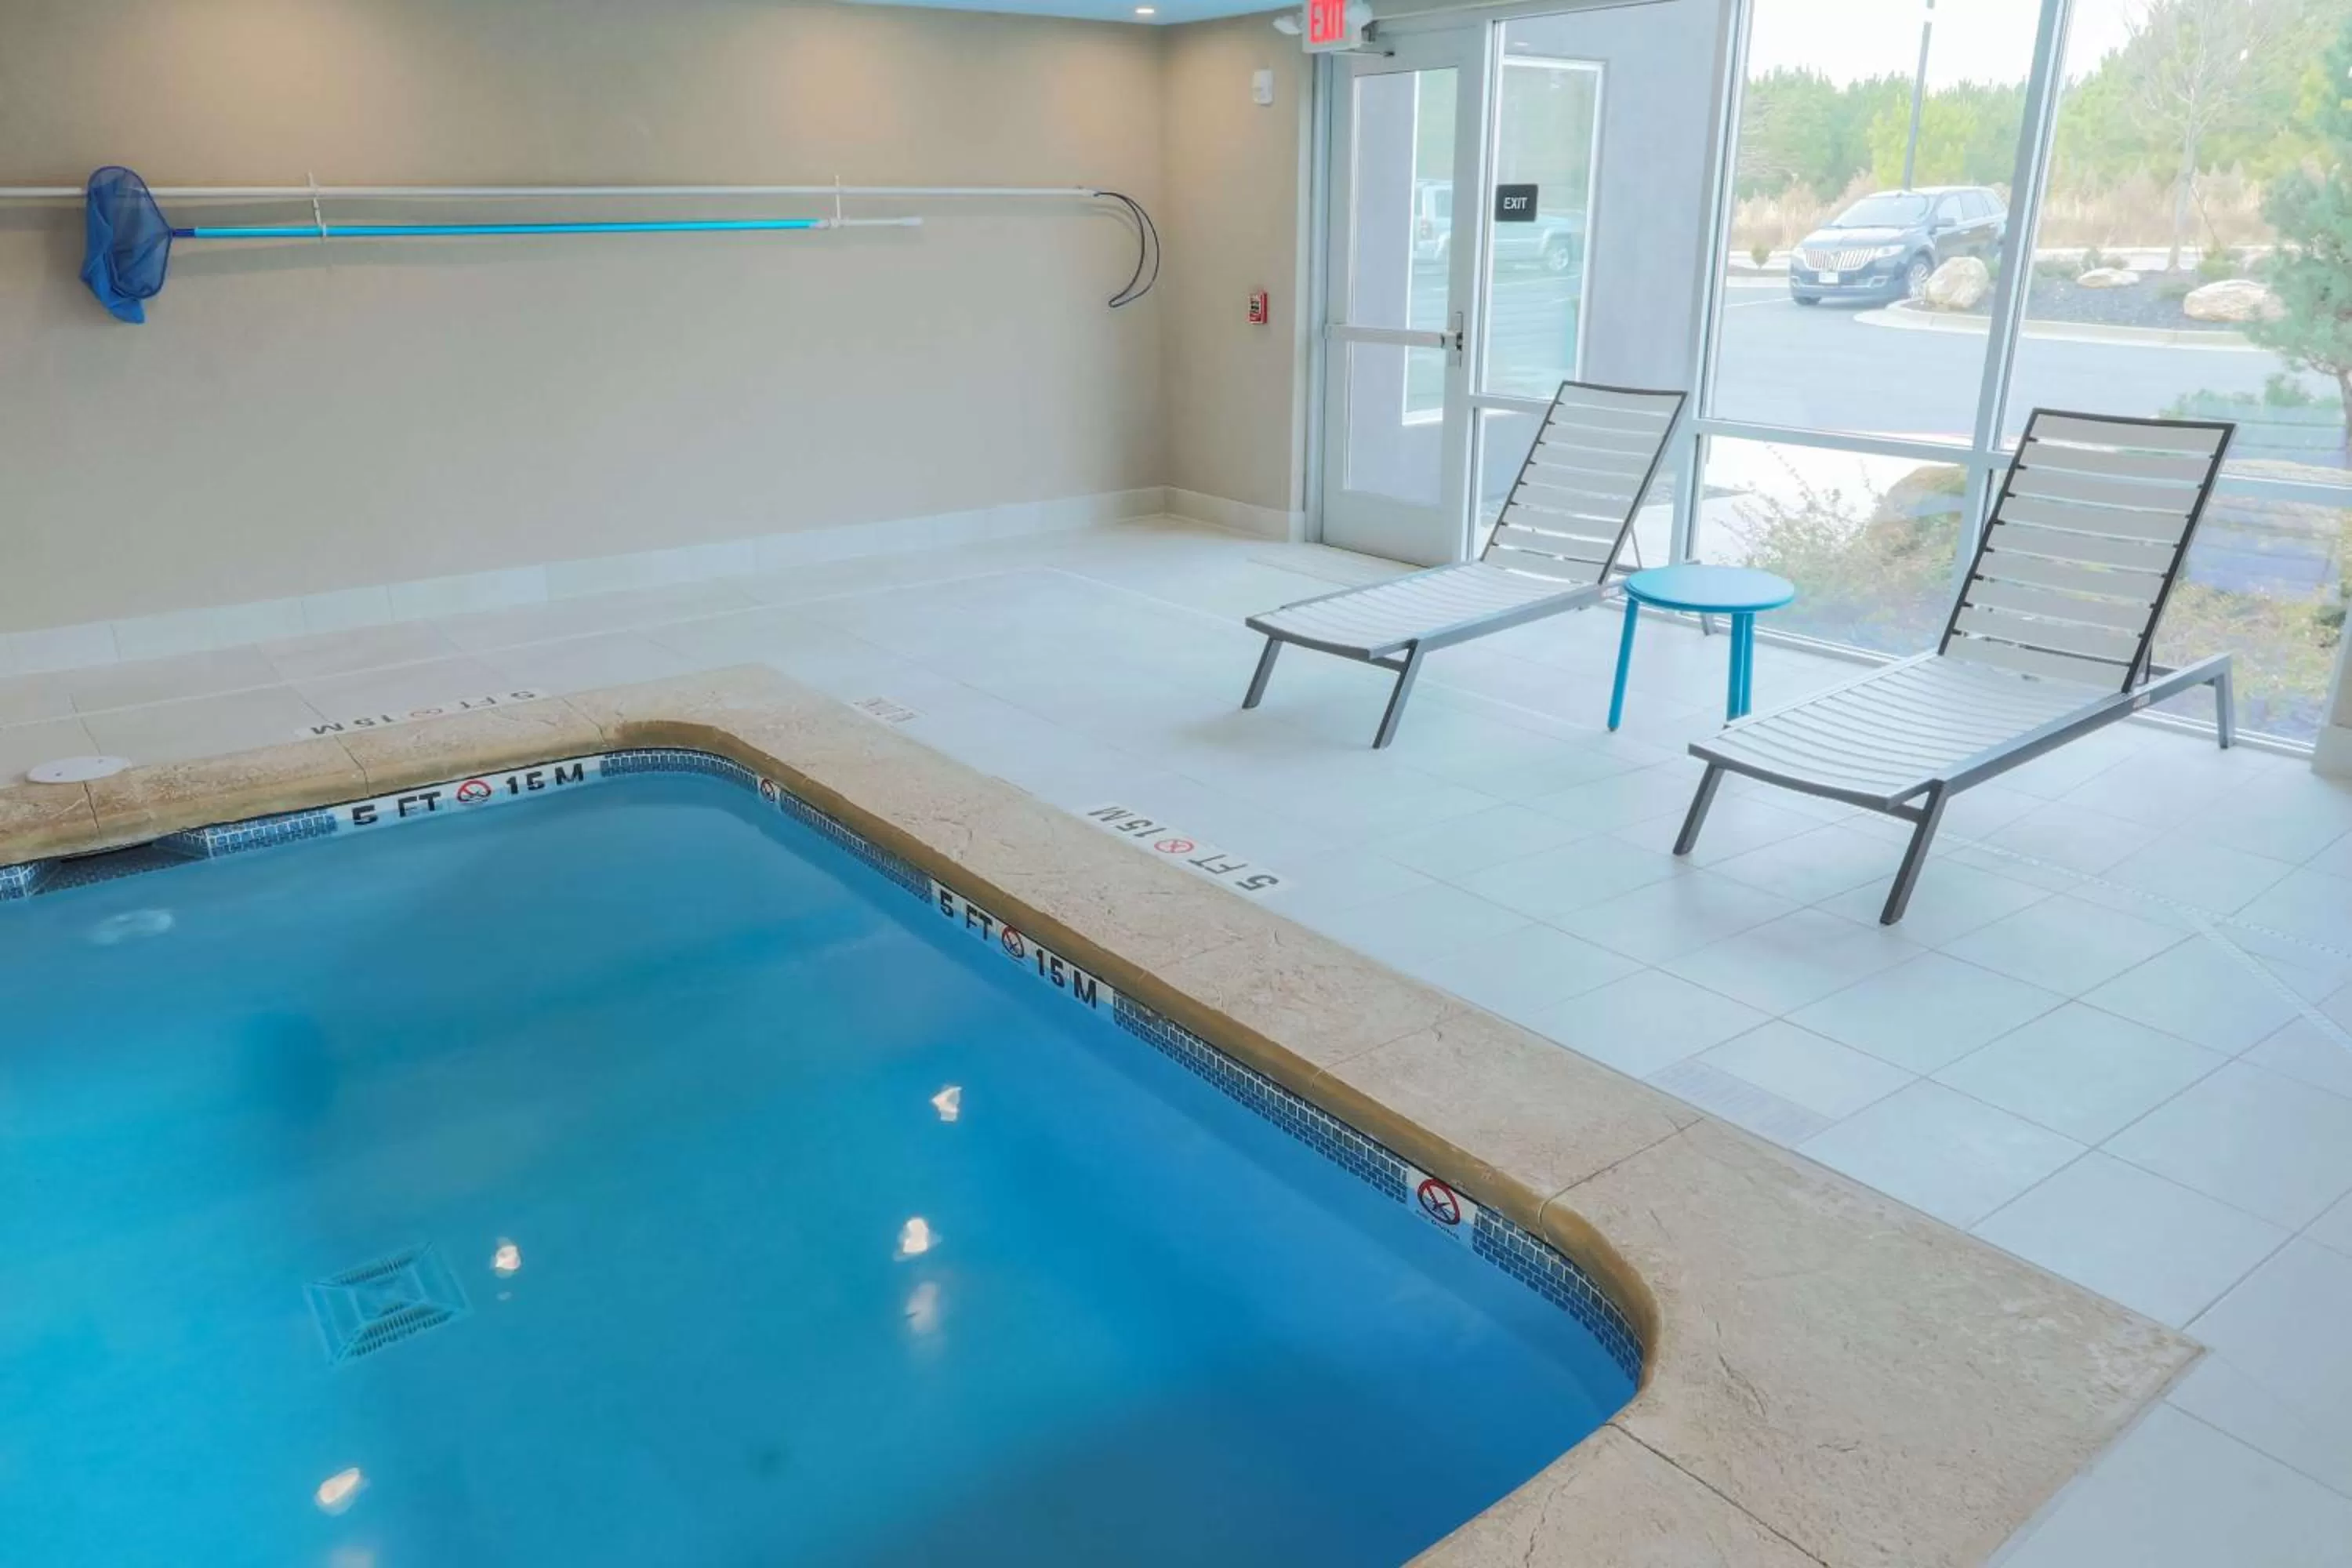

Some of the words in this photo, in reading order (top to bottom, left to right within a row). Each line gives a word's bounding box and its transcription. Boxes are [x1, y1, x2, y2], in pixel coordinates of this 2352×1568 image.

[1309, 0, 1345, 42] EXIT
[1503, 196, 1528, 210] EXIT
[352, 804, 378, 826] 5
[397, 791, 441, 818] FT
[1187, 854, 1248, 874] FT
[1235, 874, 1279, 891] 5
[940, 888, 954, 918] 5
[965, 903, 993, 941] FT
